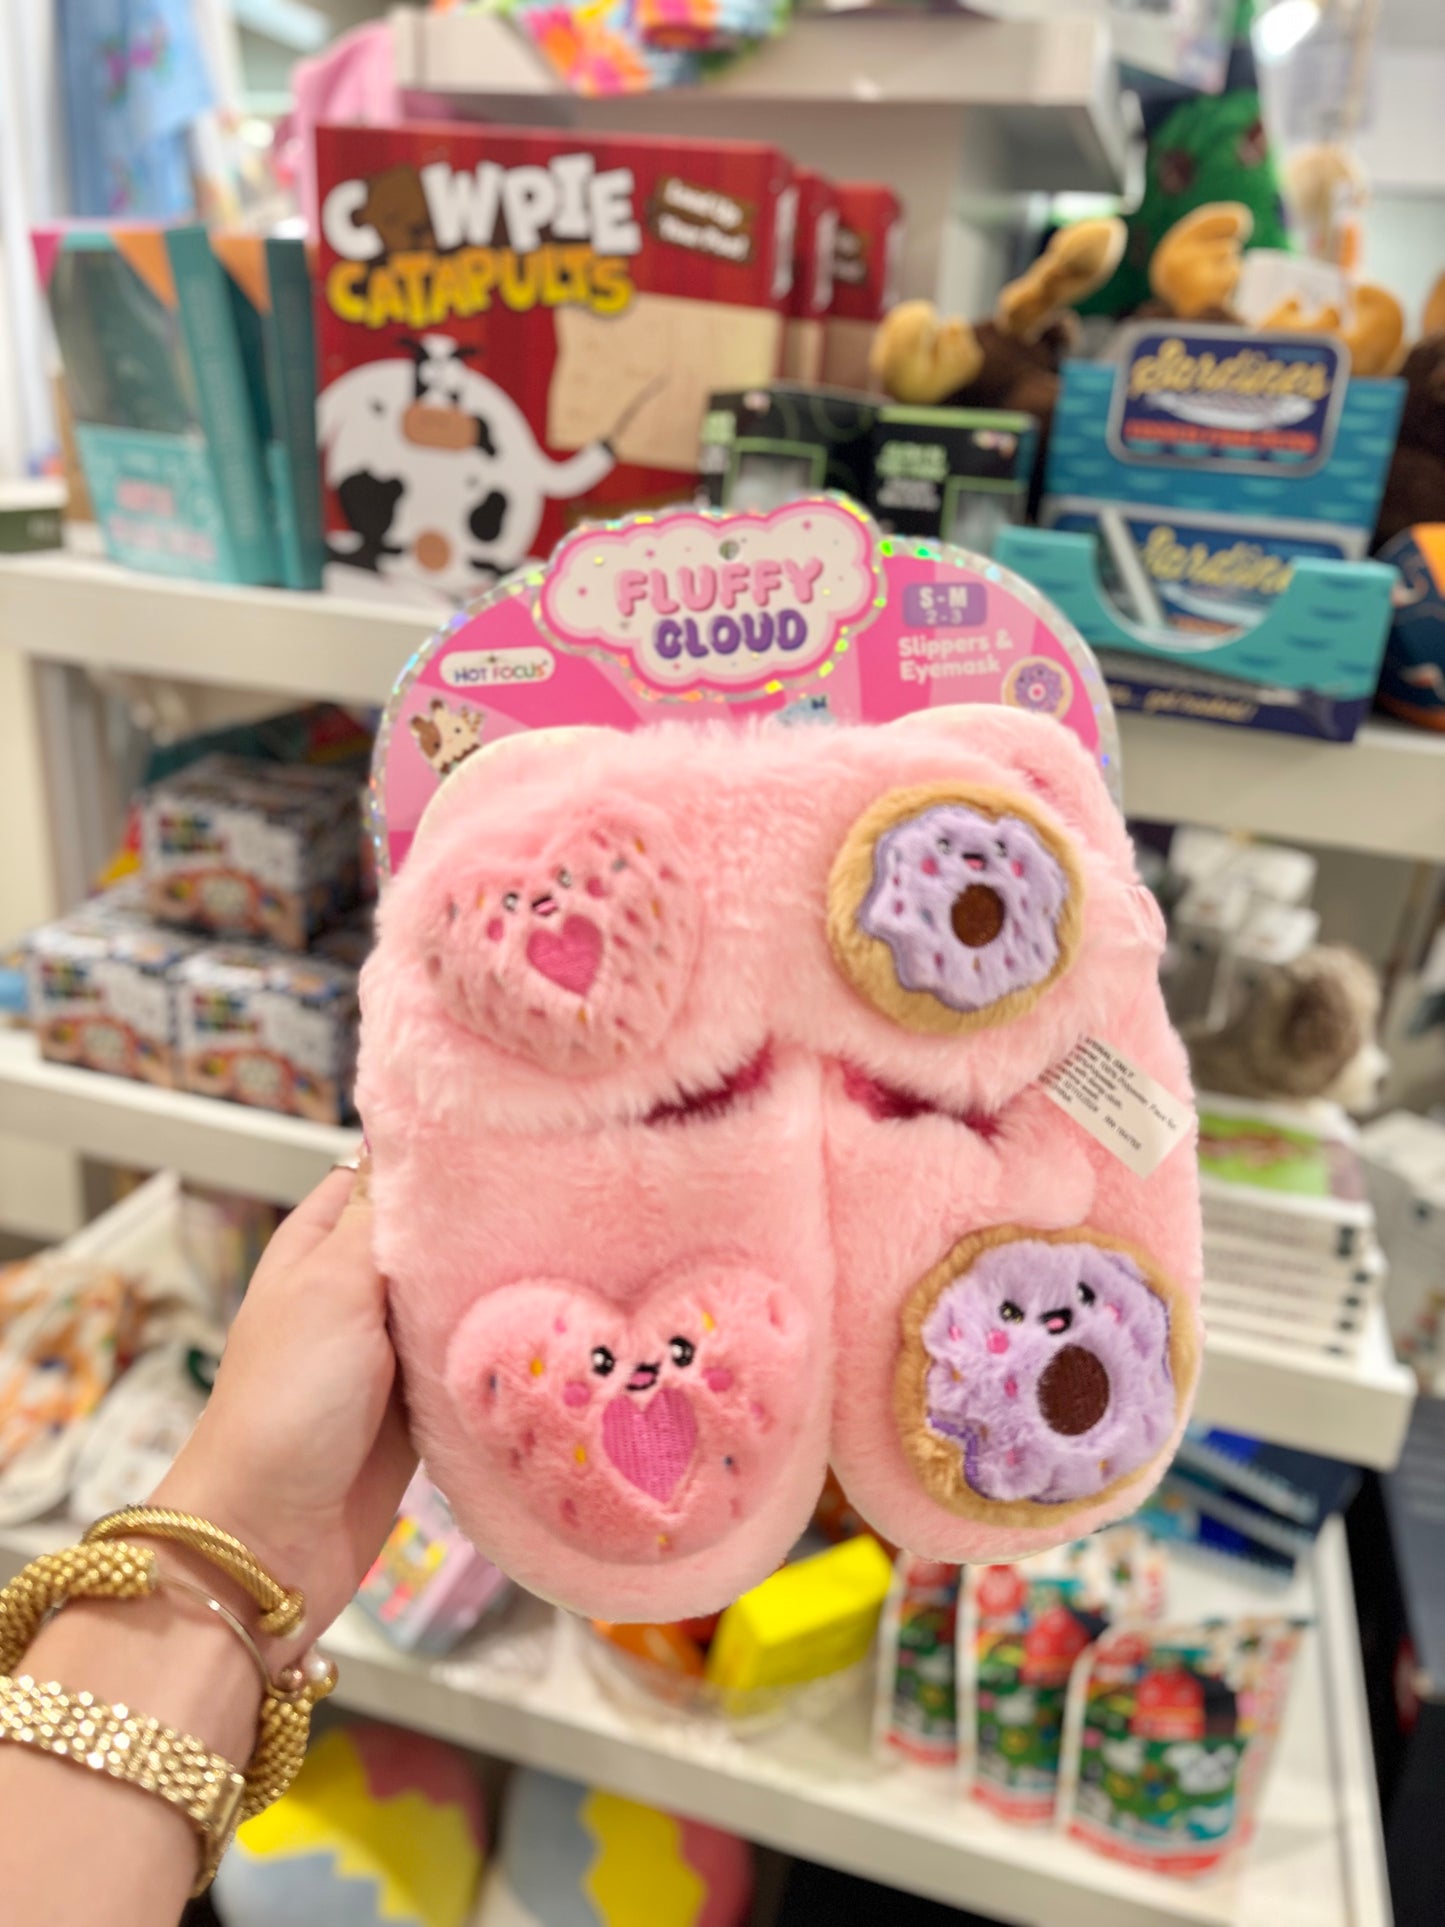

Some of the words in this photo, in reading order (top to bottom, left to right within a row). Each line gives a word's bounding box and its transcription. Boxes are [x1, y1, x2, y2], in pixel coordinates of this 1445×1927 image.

[326, 243, 635, 329] CATAPULTS
[616, 557, 824, 618] FLUFFY
[654, 609, 808, 659] CLOUD
[898, 634, 990, 661] Slippers
[995, 628, 1014, 650] &
[454, 666, 487, 683] HOT
[492, 662, 545, 680] FOCUS
[899, 653, 1001, 685] Eyemask
